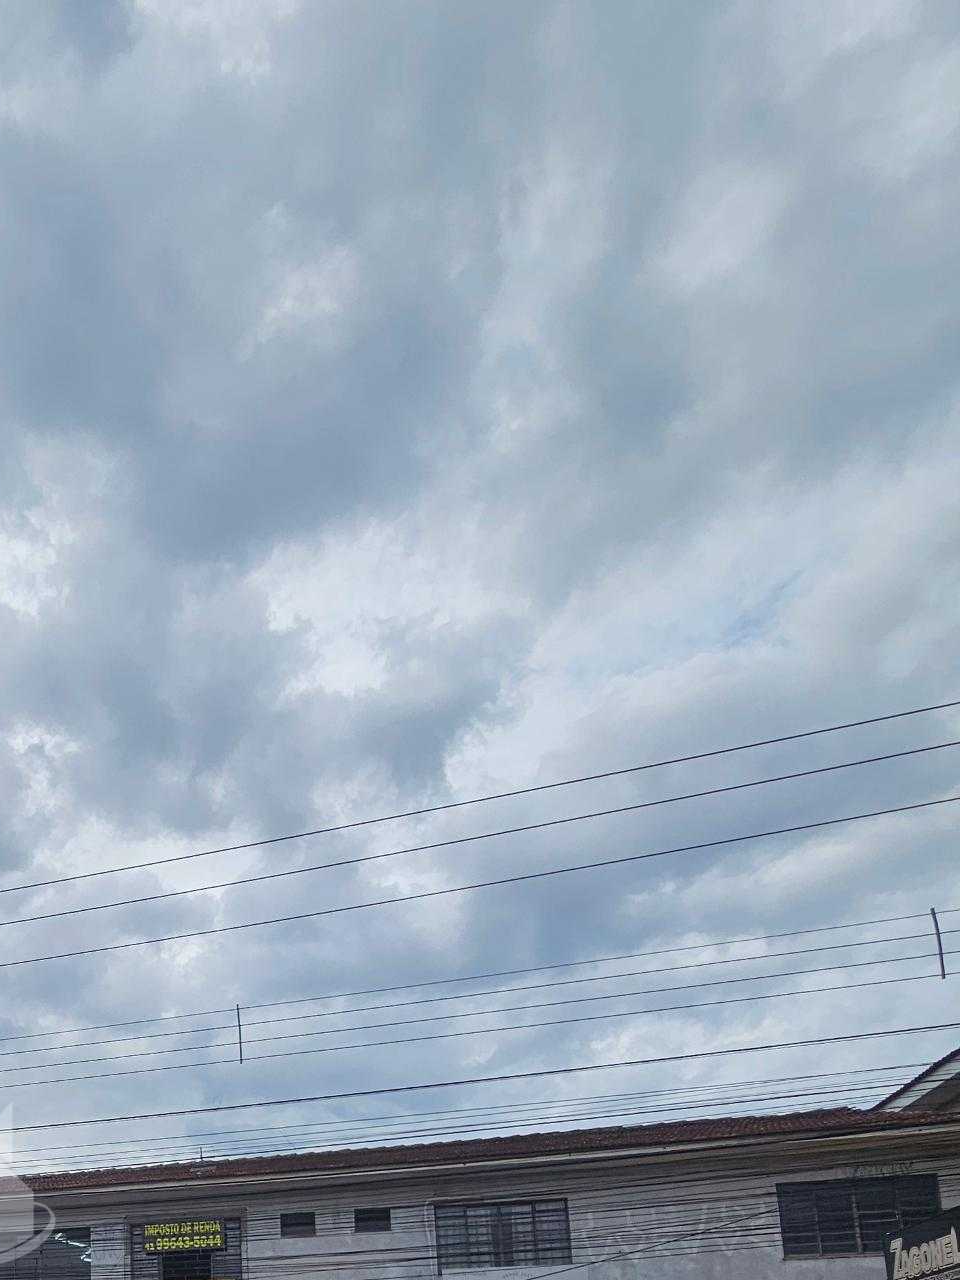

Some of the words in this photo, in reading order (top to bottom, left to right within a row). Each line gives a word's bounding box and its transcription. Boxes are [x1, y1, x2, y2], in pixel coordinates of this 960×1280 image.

[144, 1223, 180, 1236] IMPOSTO
[181, 1222, 193, 1233] DE
[194, 1220, 222, 1233] RENDA
